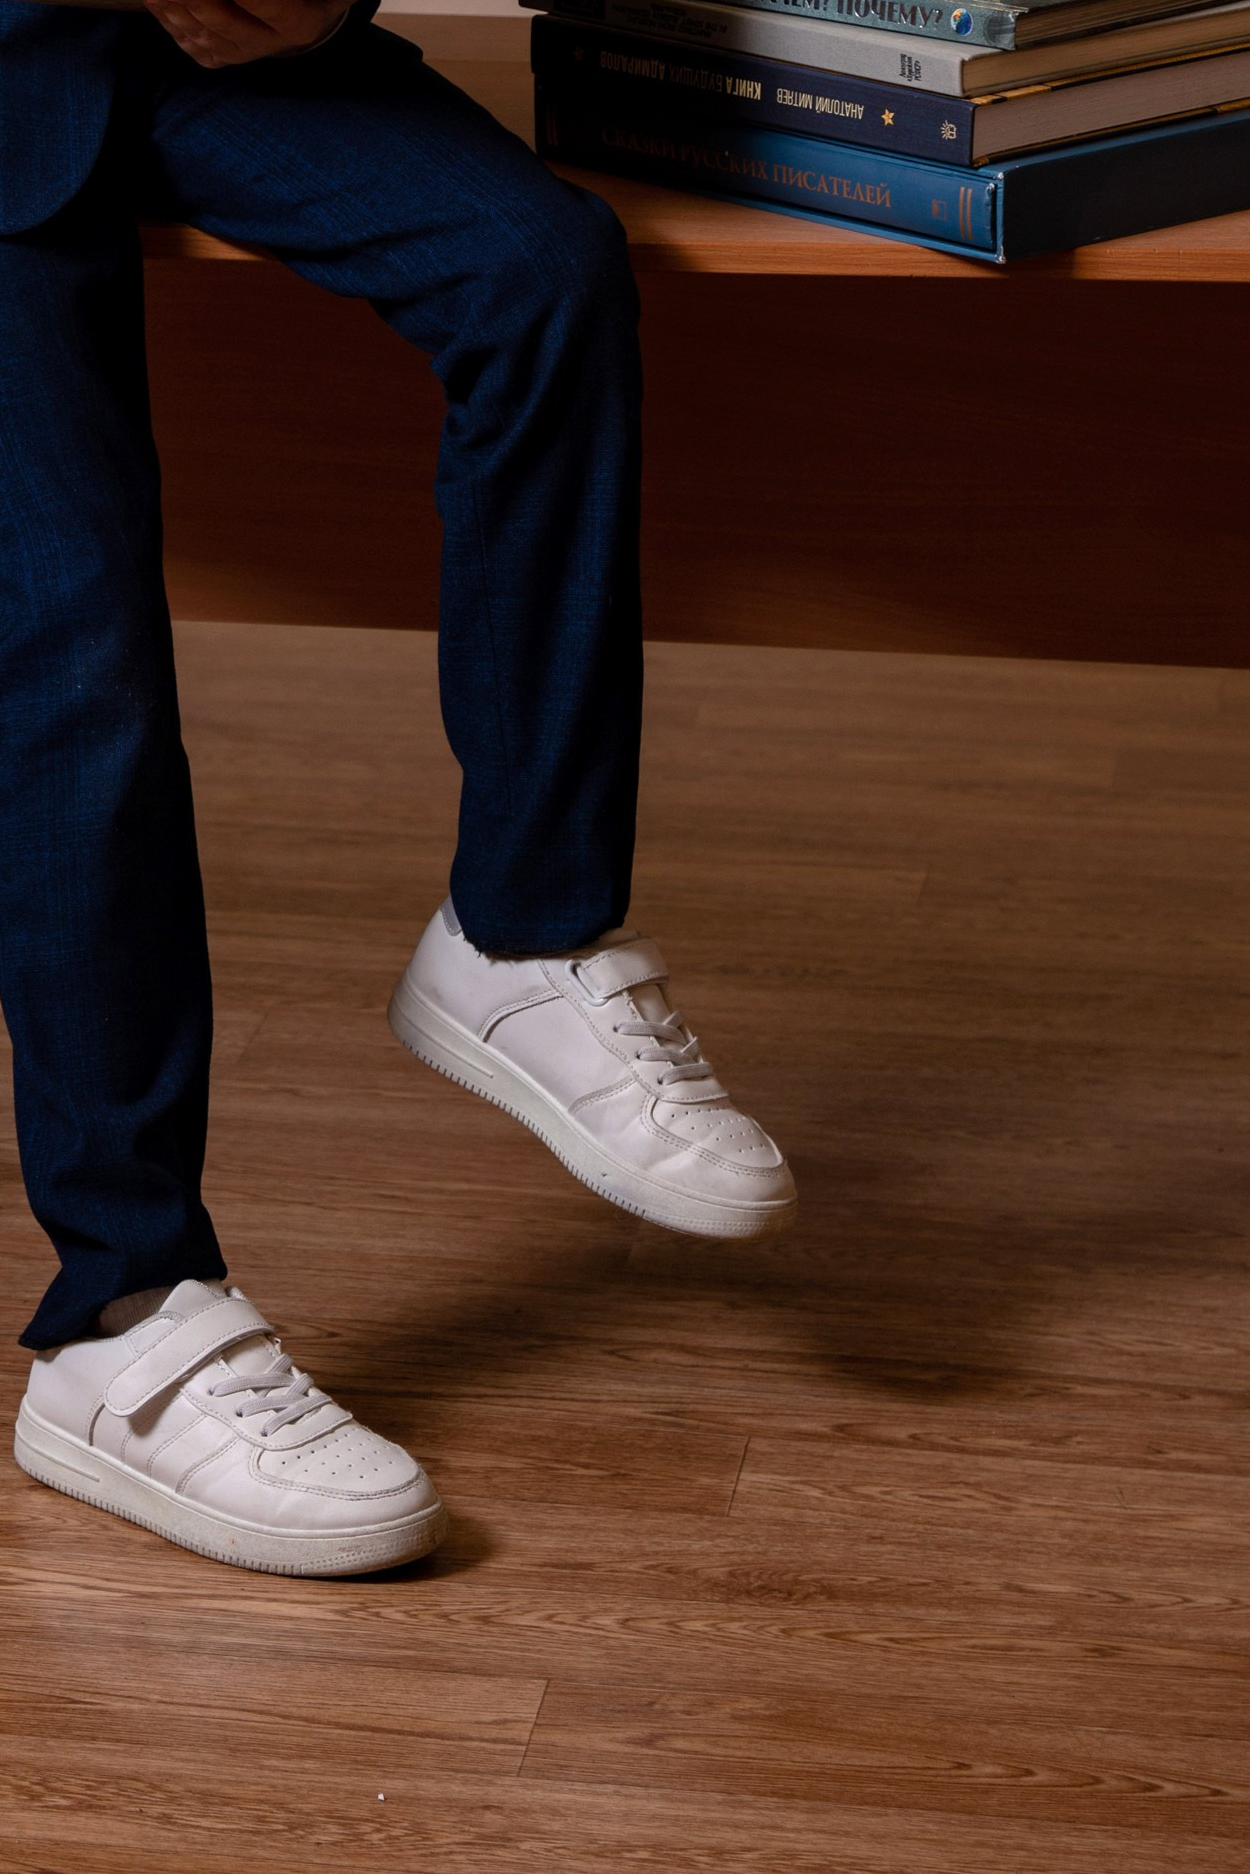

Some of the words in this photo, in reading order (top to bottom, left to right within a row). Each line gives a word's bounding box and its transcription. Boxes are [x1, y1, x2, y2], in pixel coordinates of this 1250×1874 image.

[600, 50, 666, 80] АДМИРАЛОВ
[668, 61, 724, 92] БУДУЩИХ
[725, 74, 762, 101] КНИГА
[776, 87, 813, 111] МИТЯЕВ
[815, 95, 864, 121] АНАТОЛИЙ
[677, 140, 769, 182] РУССКИХ
[772, 163, 893, 208] ПИСАТЕЛЕЙ
